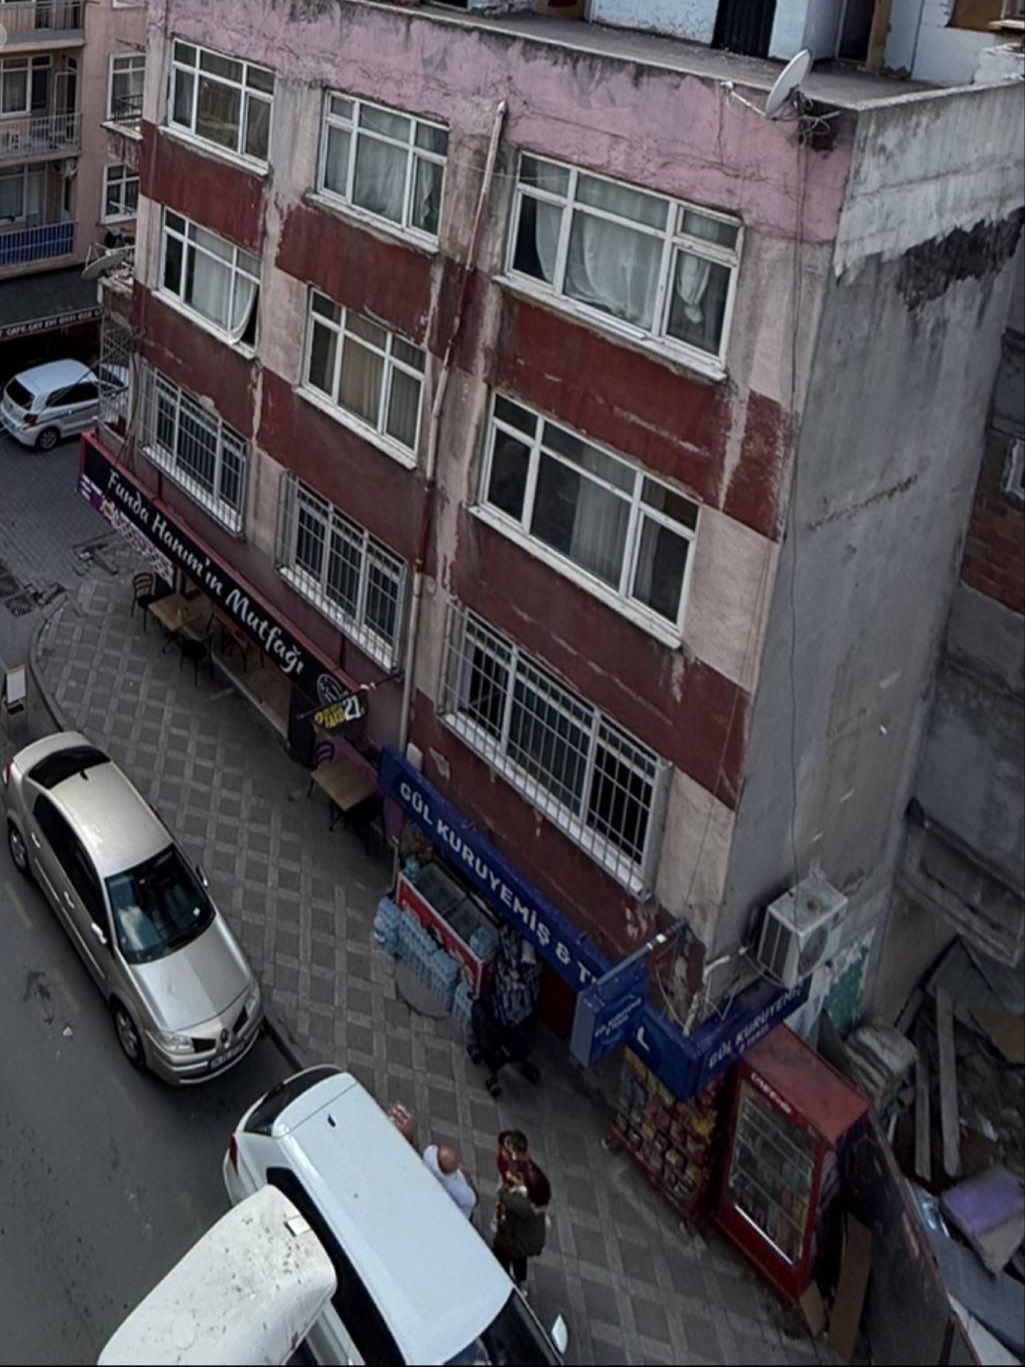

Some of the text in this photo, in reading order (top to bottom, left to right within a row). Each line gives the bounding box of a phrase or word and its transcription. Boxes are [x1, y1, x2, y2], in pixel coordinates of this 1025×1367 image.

[107, 469, 150, 524] Funda
[224, 588, 304, 674] Mutfağı
[400, 782, 433, 825] GÜL
[436, 818, 551, 947] KURUYEMİŞ
